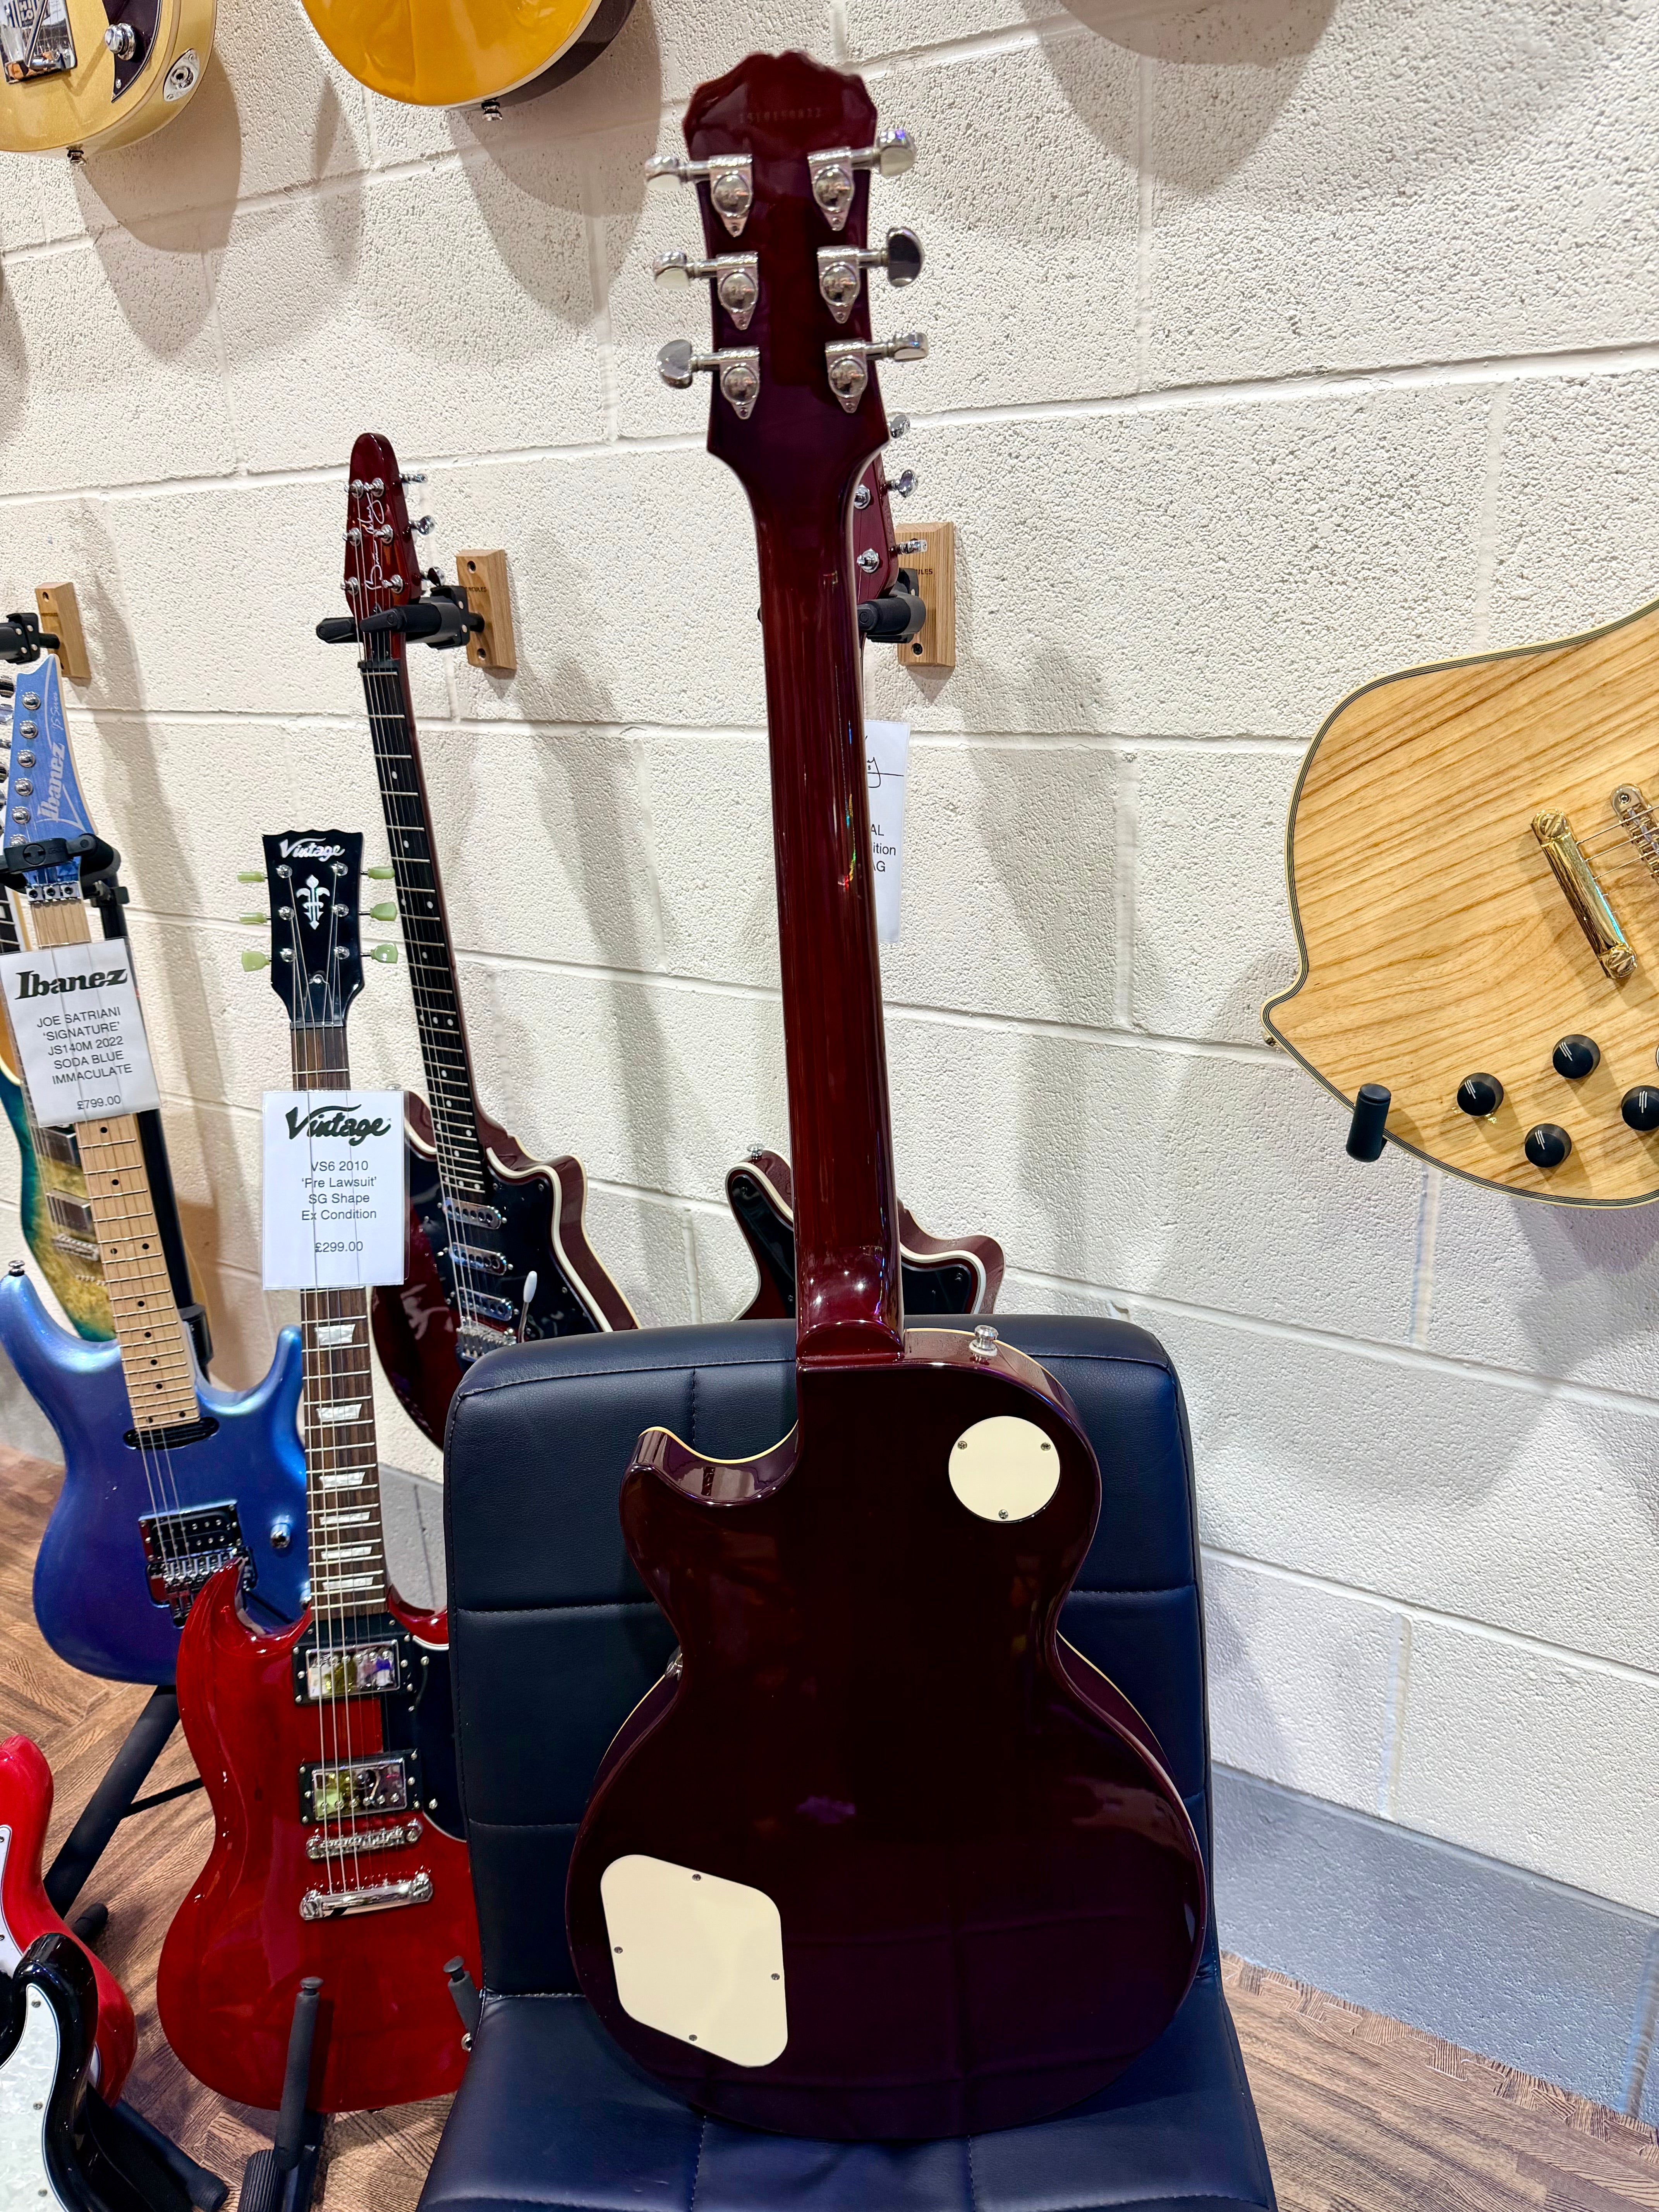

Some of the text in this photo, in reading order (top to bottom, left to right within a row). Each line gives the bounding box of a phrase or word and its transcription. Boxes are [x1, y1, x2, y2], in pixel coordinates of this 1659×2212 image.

[37, 741, 65, 823] Ibanez
[279, 838, 345, 862] Vintage
[14, 969, 128, 1000] Ibanez
[37, 1006, 120, 1028] JOE SATRIANI
[48, 1036, 124, 1056] JS140M 2022
[54, 1051, 124, 1070] SODA BLUE
[52, 1063, 132, 1085] IMMACULATE
[77, 1095, 121, 1110] £799.00
[285, 1104, 391, 1146] Vintage
[311, 1161, 368, 1171] VS6 2010
[309, 1193, 370, 1205] SG Shape
[302, 1209, 377, 1221] Ex Condition
[315, 1242, 363, 1252] £299.00
